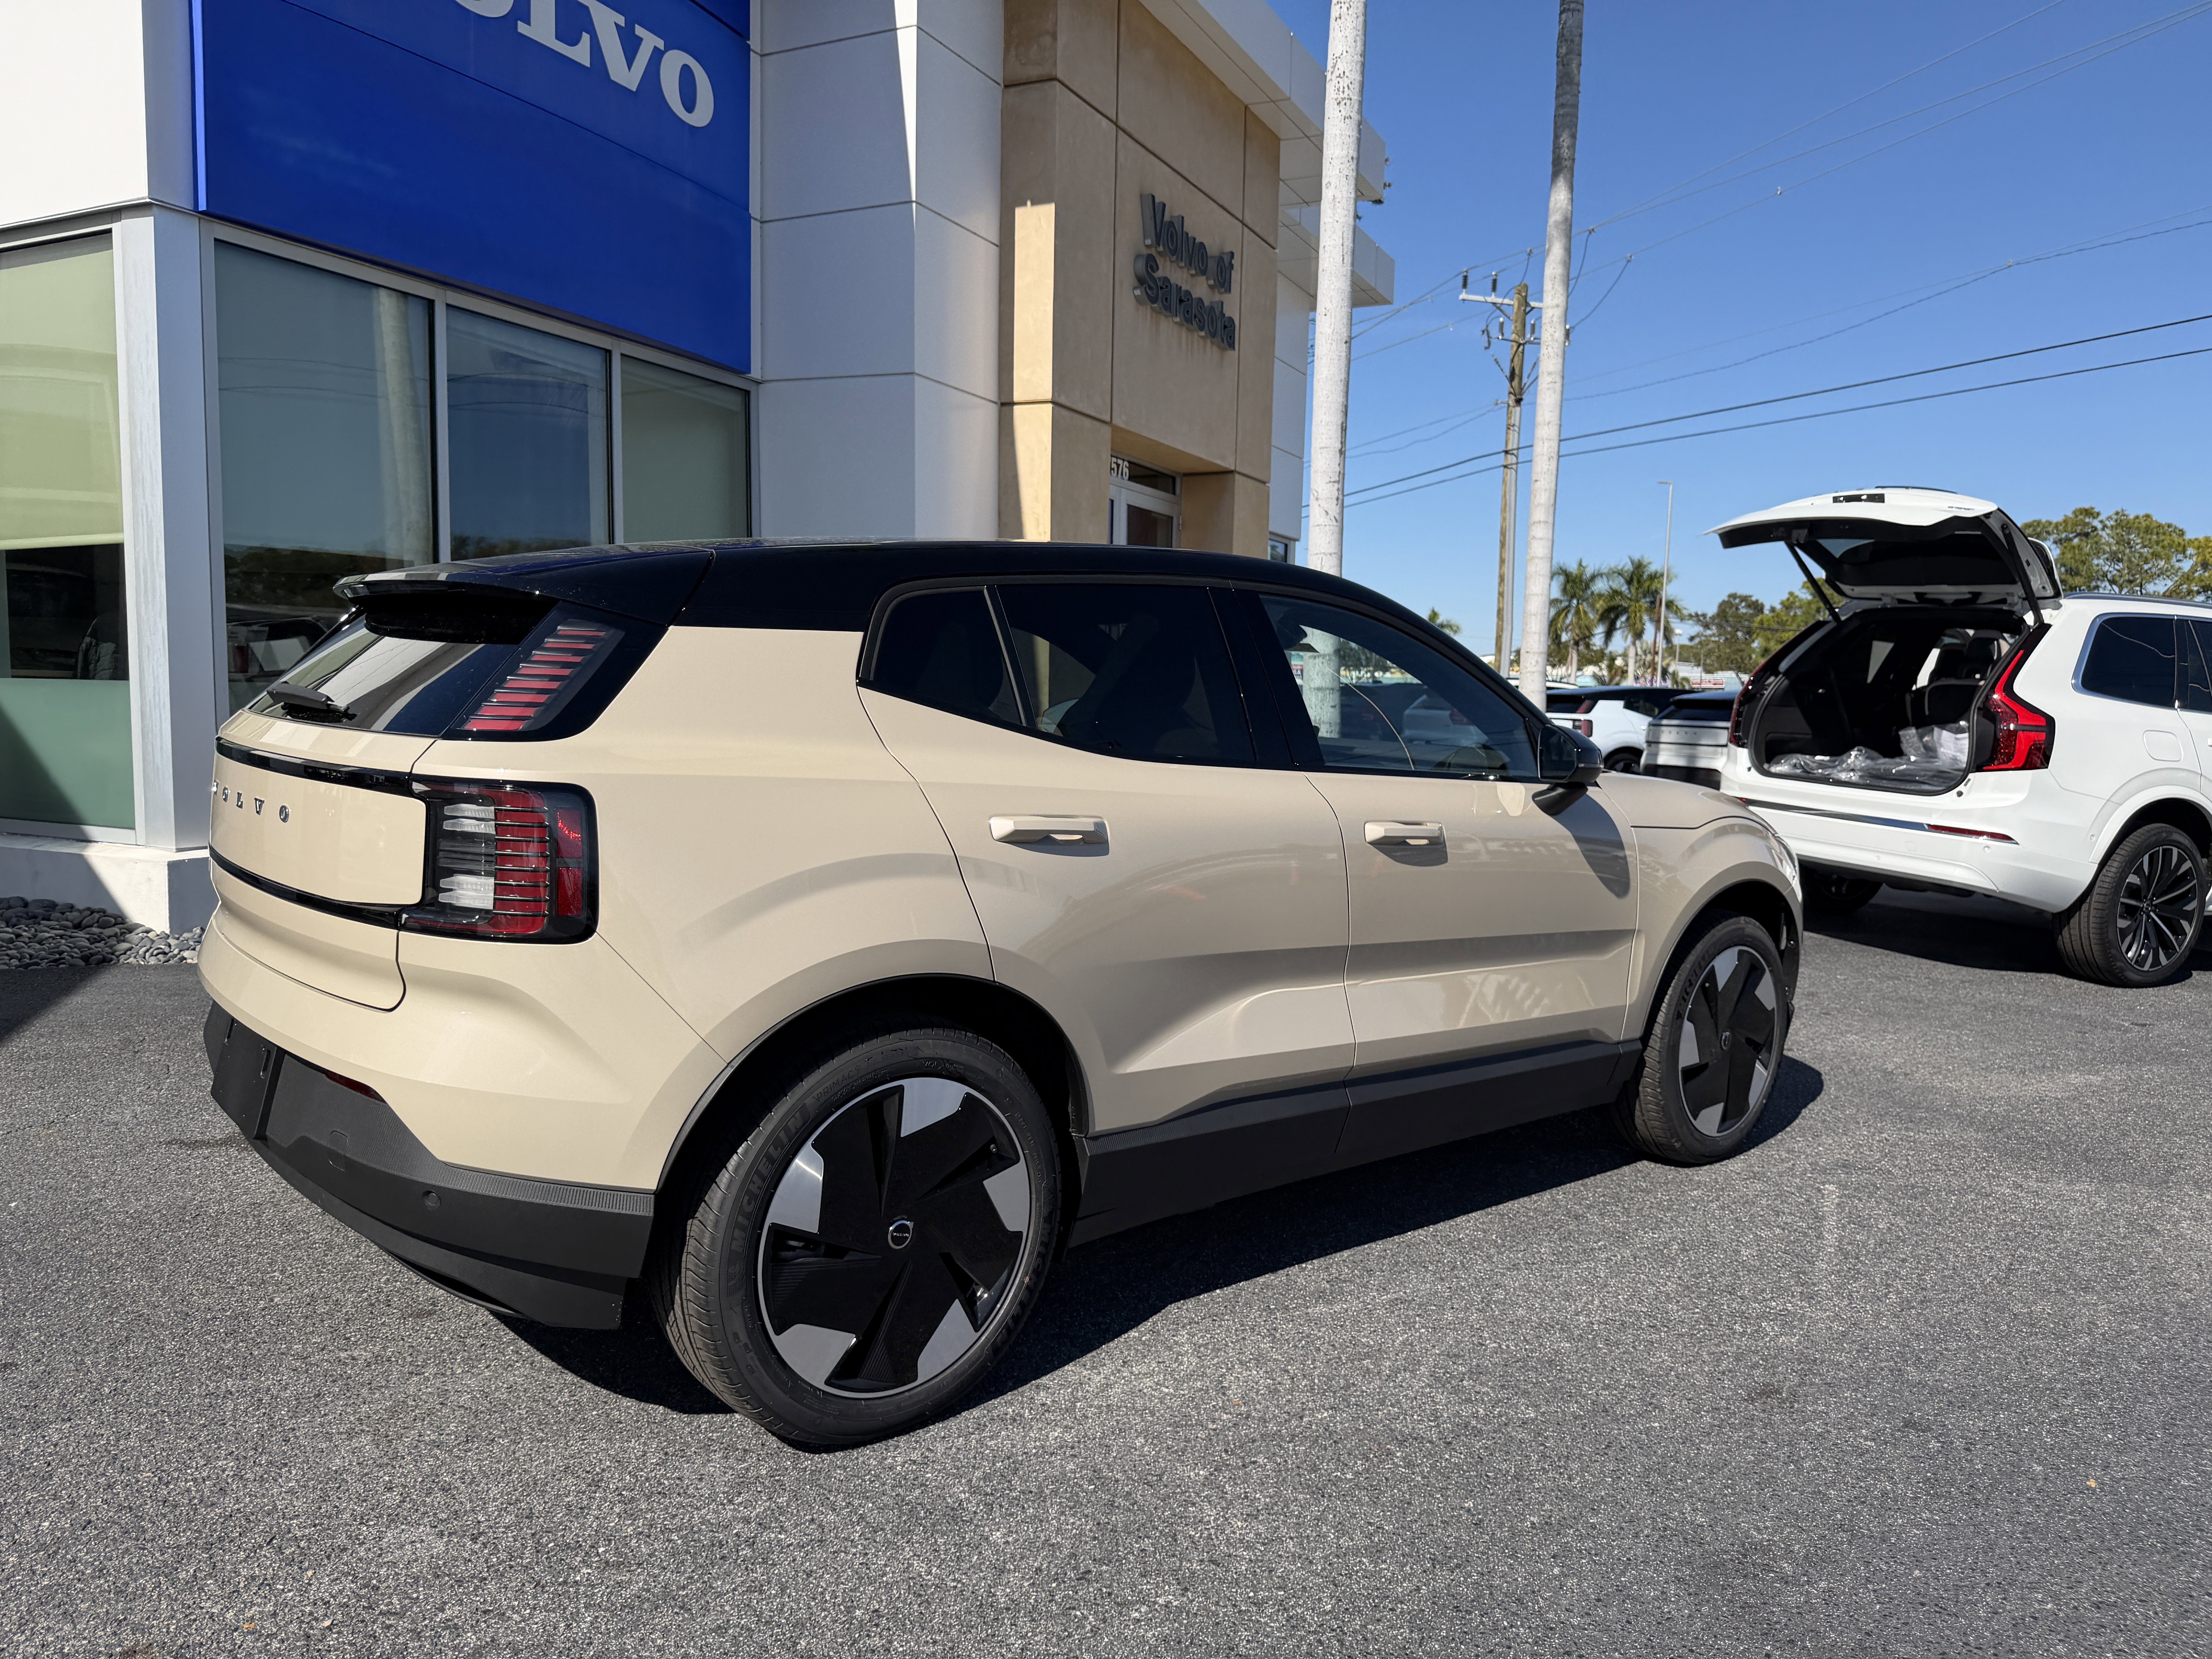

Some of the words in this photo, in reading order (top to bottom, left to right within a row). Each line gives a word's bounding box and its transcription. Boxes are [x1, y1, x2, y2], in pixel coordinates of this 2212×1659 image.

[454, 0, 714, 127] LVO
[1140, 194, 1208, 276] Volvo
[1206, 251, 1234, 294] of
[1133, 254, 1235, 350] Sarasota
[1111, 457, 1129, 480] 576
[812, 1065, 861, 1102] PRIMACY
[731, 1111, 804, 1253] MICHELIN
